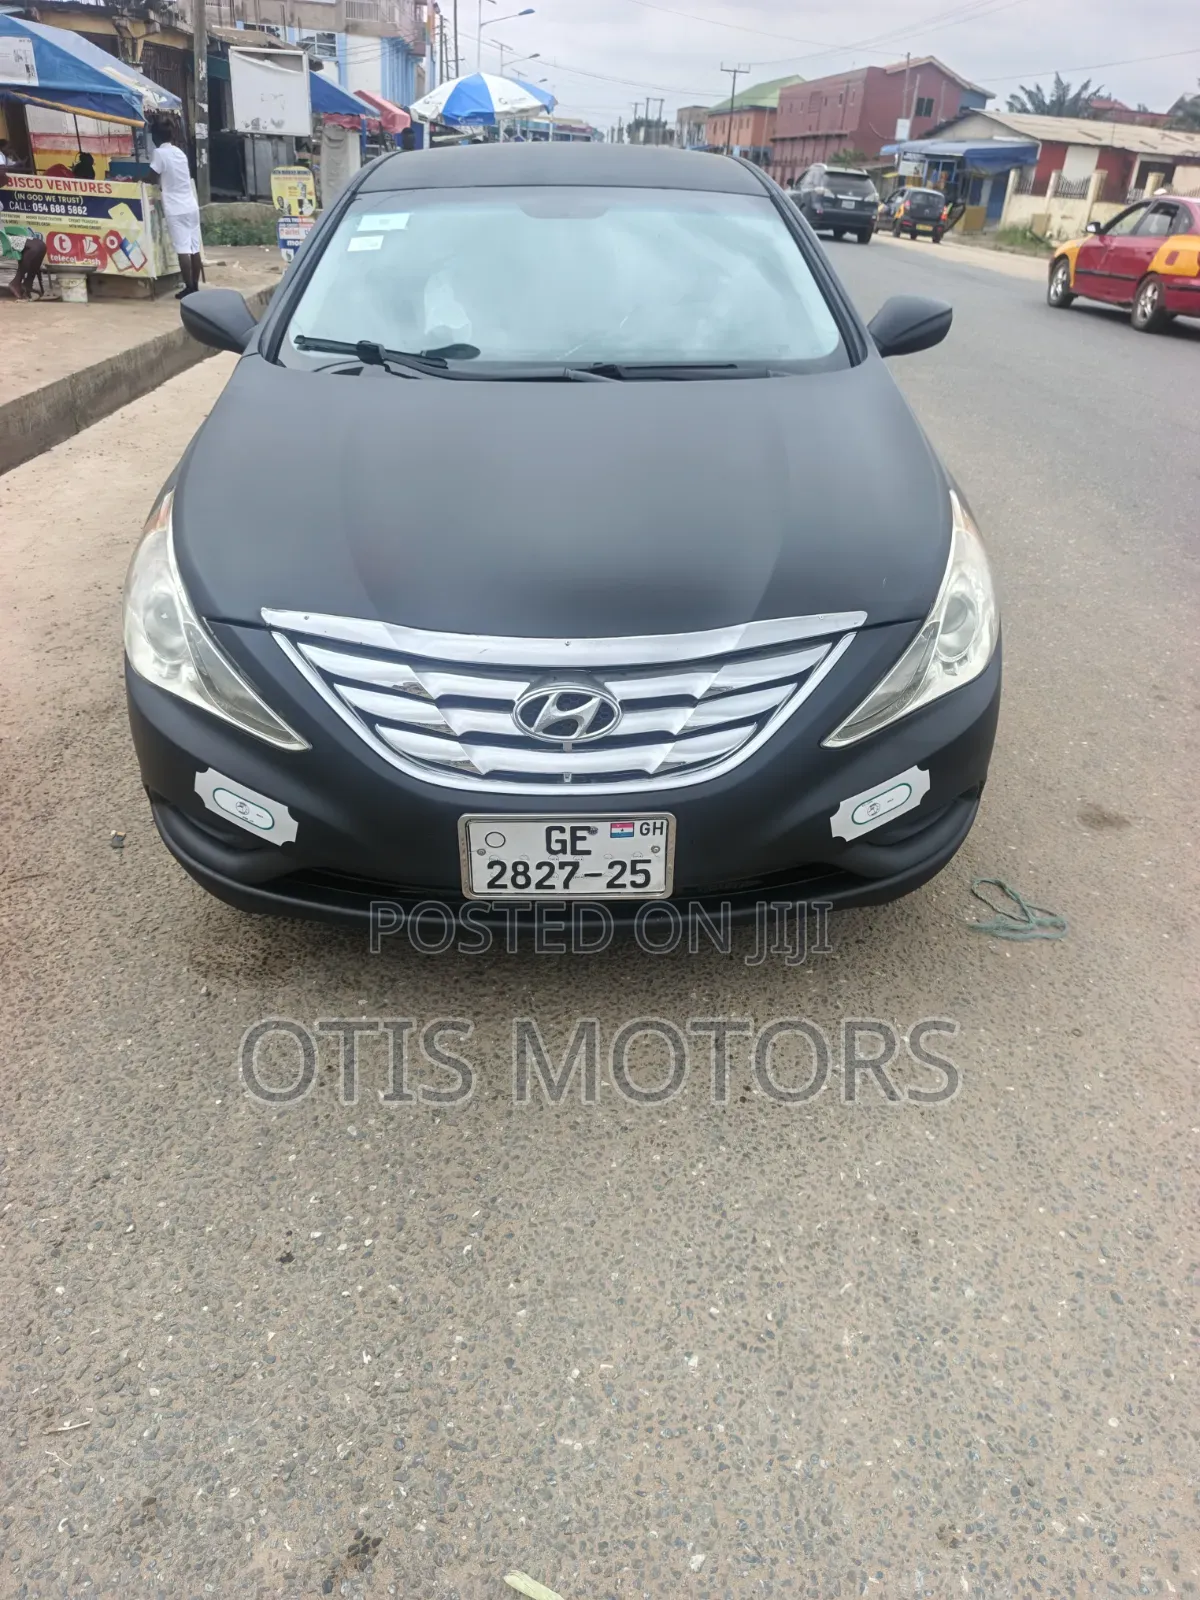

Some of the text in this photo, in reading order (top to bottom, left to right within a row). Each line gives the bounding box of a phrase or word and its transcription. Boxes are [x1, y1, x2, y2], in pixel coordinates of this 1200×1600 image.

[46, 179, 112, 194] VENTURES
[14, 191, 25, 201] (IN
[45, 195, 57, 203] WE
[58, 196, 84, 205] TRUST)
[9, 201, 31, 212] CALL:
[32, 203, 49, 213] 054
[50, 204, 66, 214] 688
[50, 253, 101, 267] telecel cash
[639, 821, 664, 836] GH
[545, 826, 592, 856] GE
[486, 859, 652, 890] 2827-25
